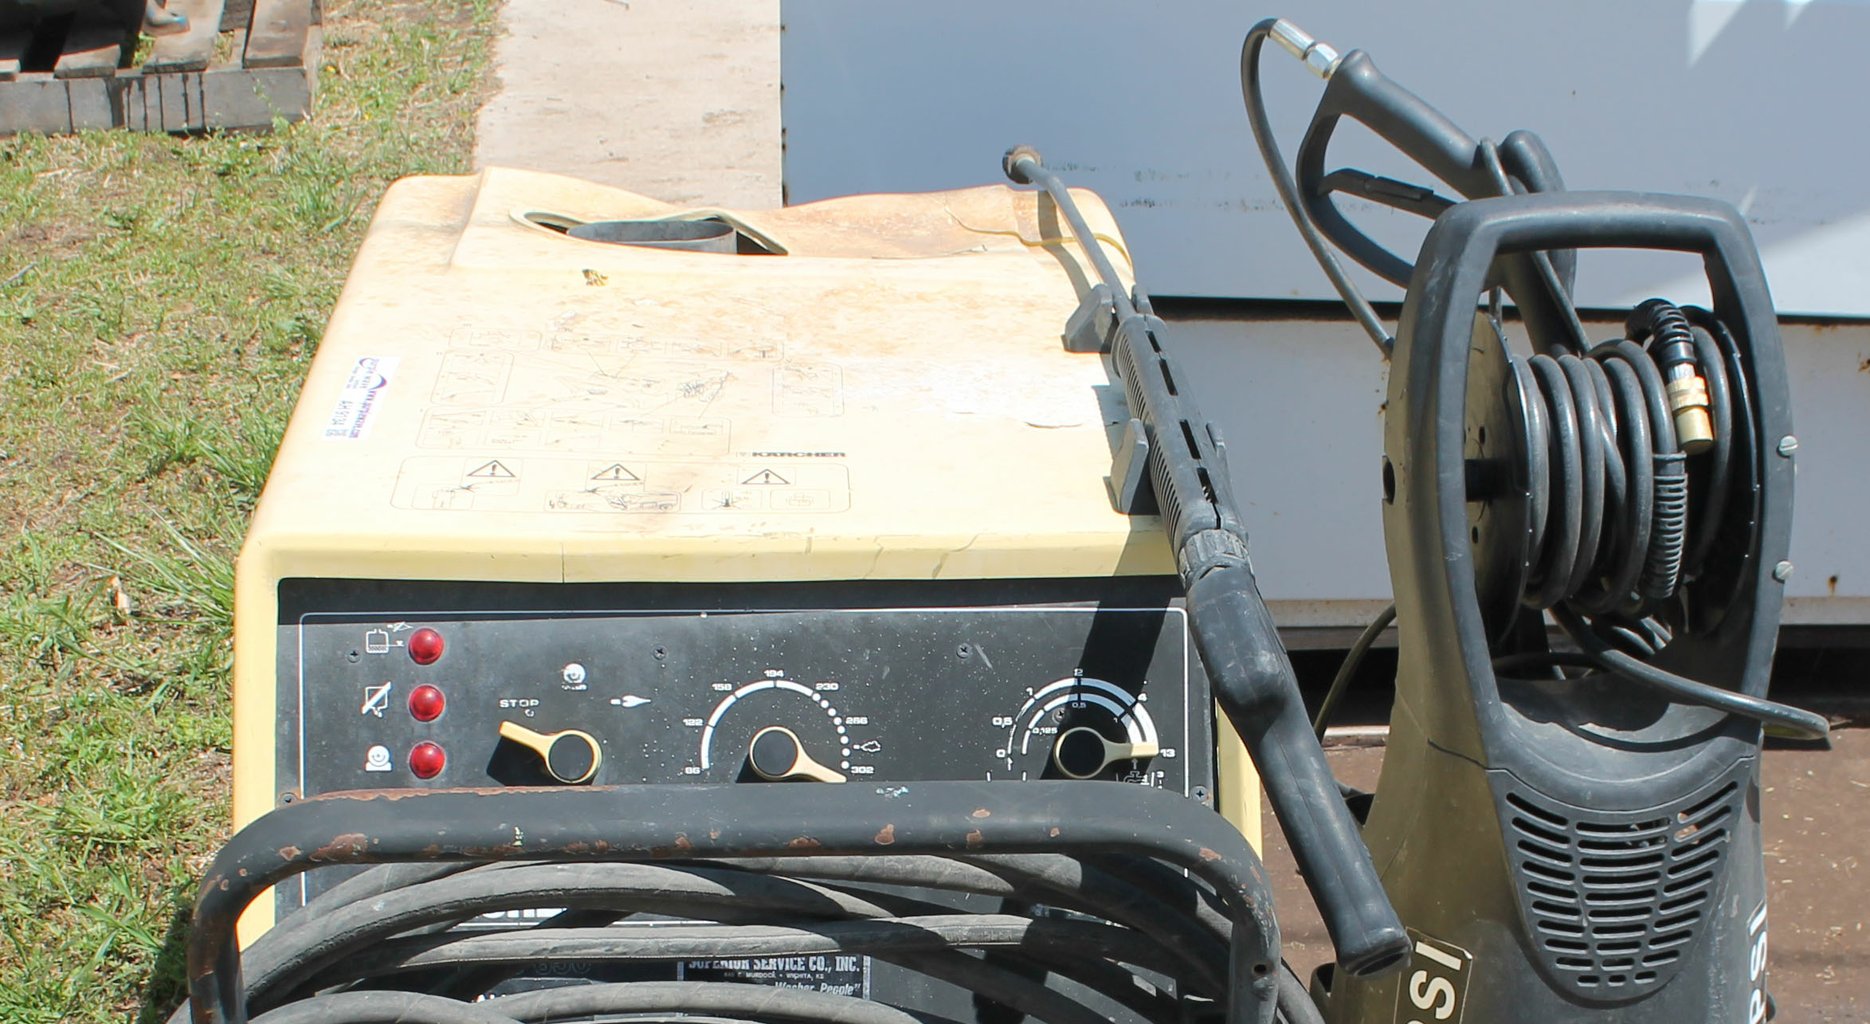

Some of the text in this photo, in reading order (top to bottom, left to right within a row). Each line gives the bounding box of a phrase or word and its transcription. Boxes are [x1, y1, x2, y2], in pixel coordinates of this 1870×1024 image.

[763, 669, 785, 678] 194
[815, 682, 839, 690] 230
[1137, 693, 1147, 701] 4
[499, 699, 540, 708] STOP
[683, 718, 703, 726] 122
[1160, 748, 1176, 757] 13
[851, 765, 874, 774] 302
[753, 957, 806, 972] SERVICE
[808, 955, 832, 973] CO.,
[835, 955, 861, 973] INC.
